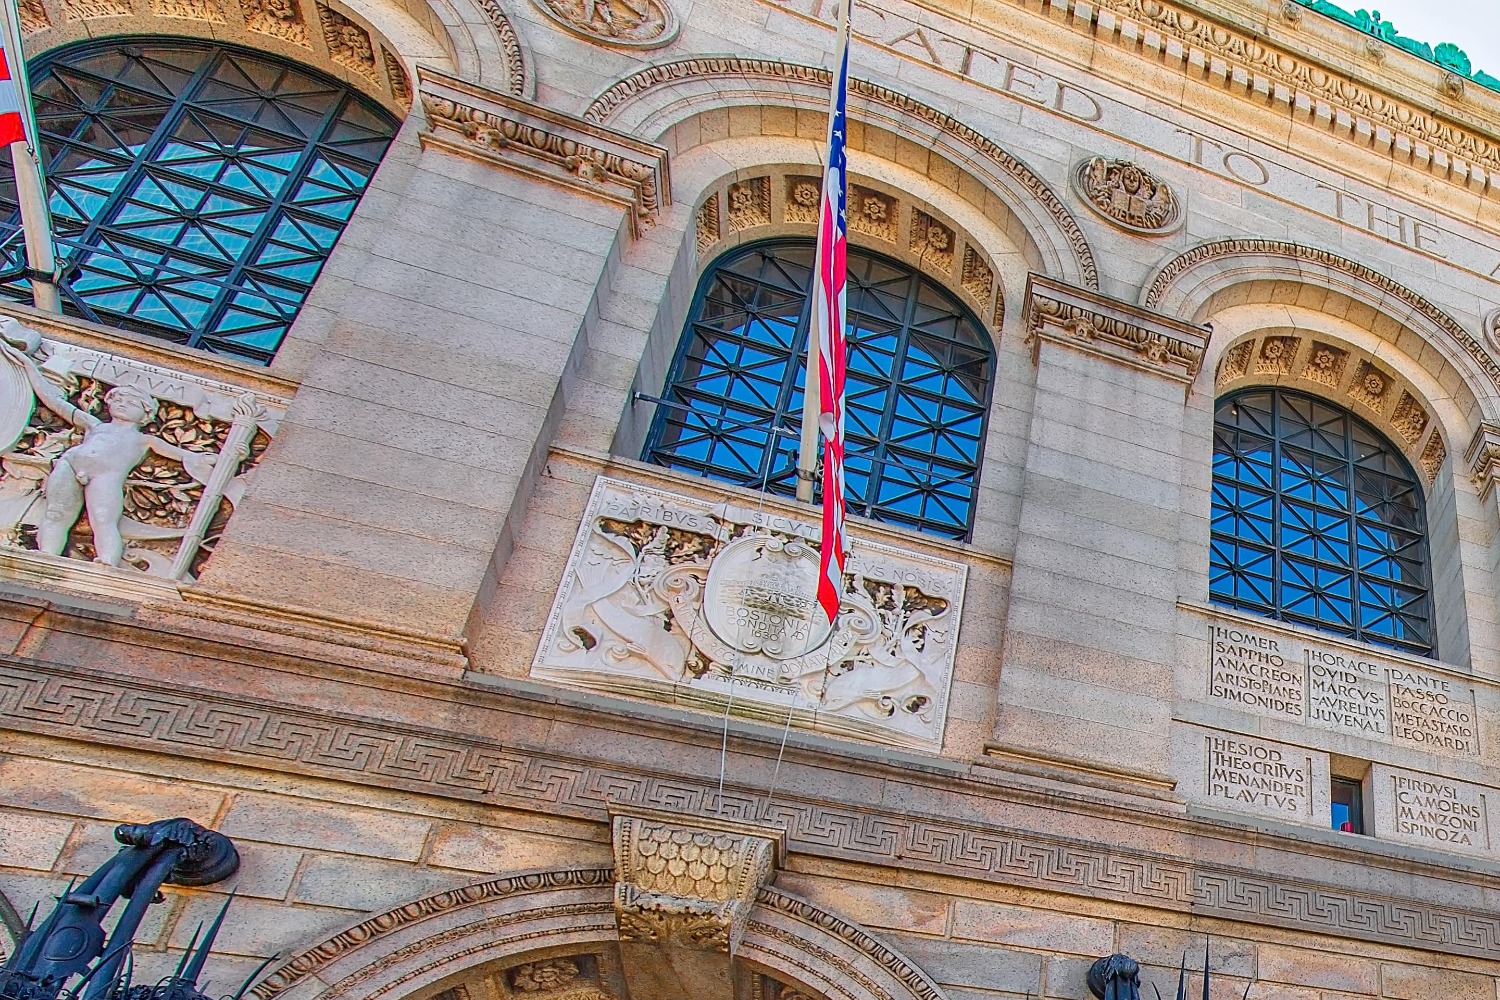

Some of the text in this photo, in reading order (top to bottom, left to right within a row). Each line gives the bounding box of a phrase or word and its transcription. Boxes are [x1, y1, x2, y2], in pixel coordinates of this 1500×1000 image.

[1176, 128, 1270, 186] TO
[1316, 183, 1448, 259] THE
[81, 359, 185, 399] CIVIVM
[752, 512, 819, 537] SICVT
[852, 560, 941, 593] EVS NOBIS
[726, 605, 809, 632] BOSTONIA
[727, 617, 787, 637] CONDITA
[752, 630, 778, 642] 1630
[1216, 628, 1279, 651] HOMER
[1216, 642, 1284, 667] SAPPHO
[1312, 650, 1378, 676] HORACE
[1214, 657, 1302, 685] ANACREON
[1312, 665, 1357, 684] OVID
[1392, 669, 1450, 692] DANTE
[1213, 685, 1303, 716] SIMONIDES
[1393, 683, 1448, 704] TASSO
[1312, 708, 1385, 734] JUVENAL
[1393, 696, 1469, 723] BOCCACCIO
[1393, 712, 1471, 736] METASTASIO
[1215, 738, 1282, 761] HESIOD
[1395, 726, 1470, 752] LEOPARDI
[1212, 768, 1305, 797] MENANDER
[1213, 784, 1297, 811] PLAVTVS
[1398, 792, 1480, 818] CAMOENS
[1400, 806, 1477, 832] MANZONI
[1401, 822, 1472, 845] SPINOZA
